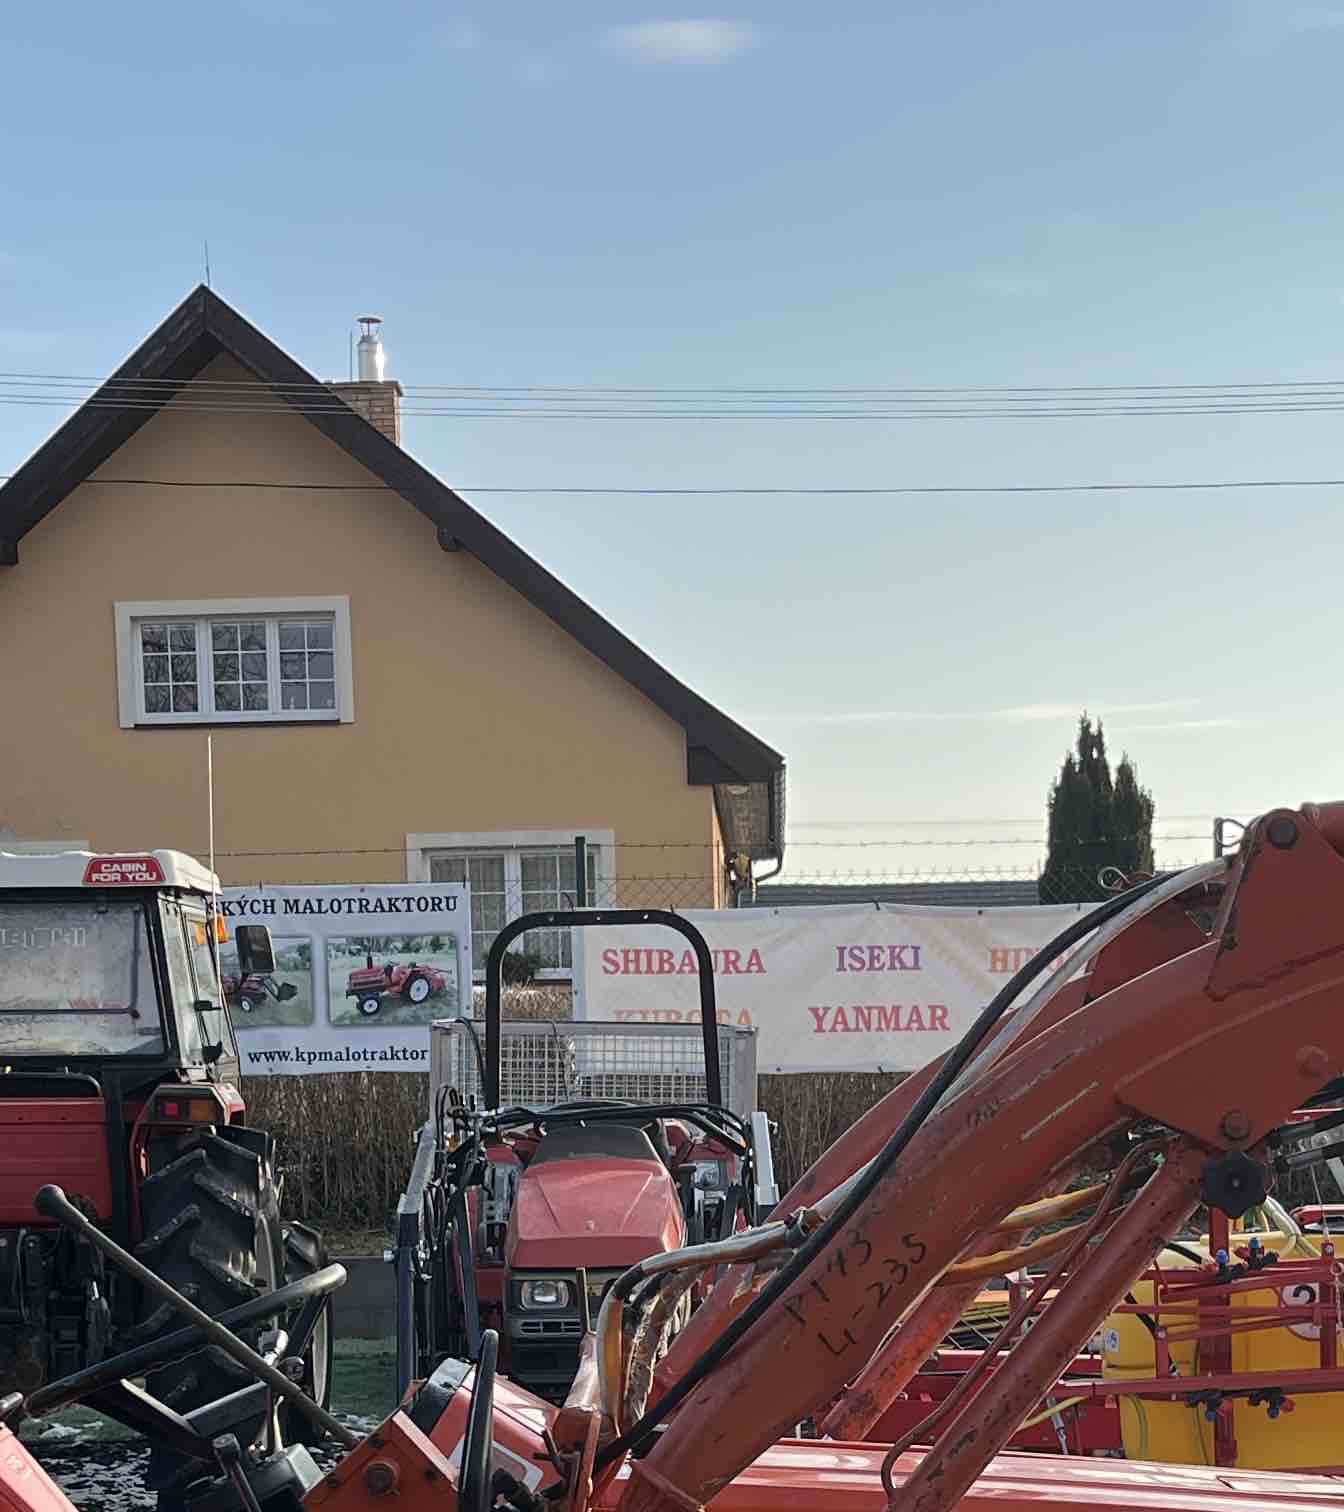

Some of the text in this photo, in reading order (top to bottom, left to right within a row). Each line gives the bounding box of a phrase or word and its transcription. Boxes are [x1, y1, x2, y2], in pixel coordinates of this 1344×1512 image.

[92, 871, 157, 882] FOR YOU
[101, 863, 147, 873] CABIN
[835, 945, 923, 972] ISEKI
[807, 1004, 951, 1033] YANMAR
